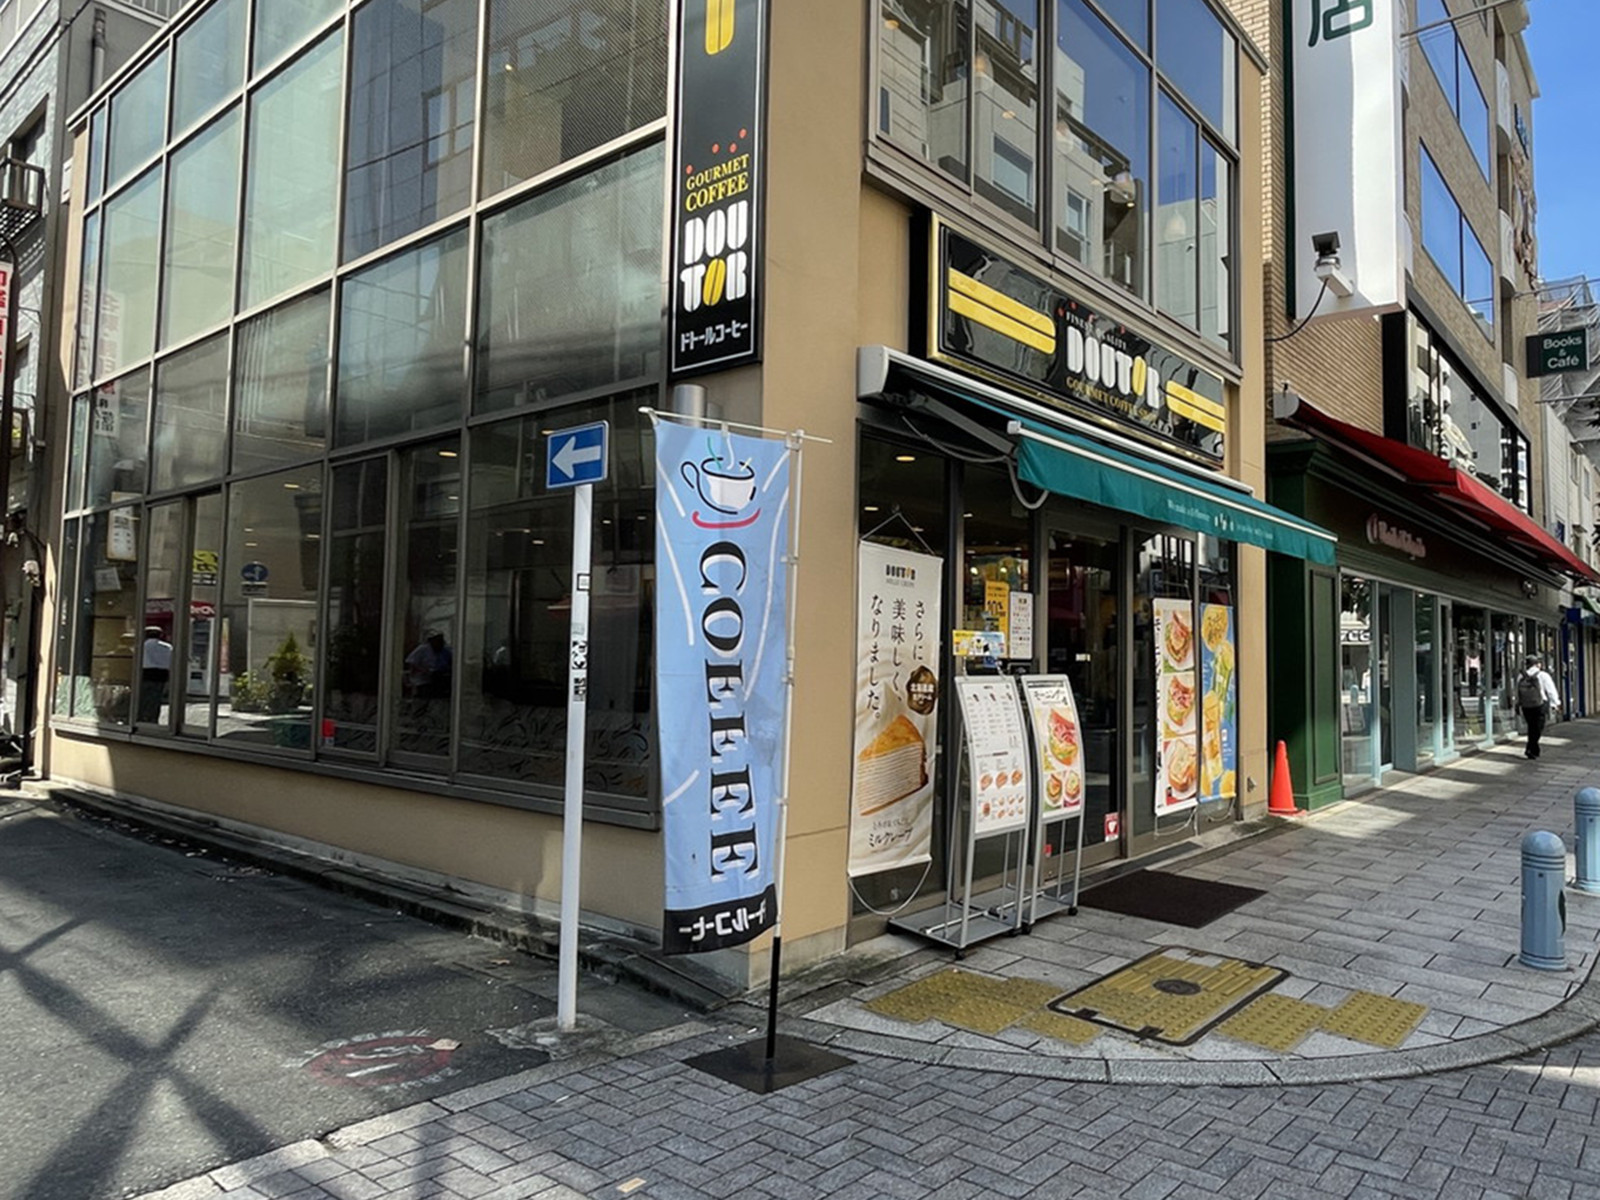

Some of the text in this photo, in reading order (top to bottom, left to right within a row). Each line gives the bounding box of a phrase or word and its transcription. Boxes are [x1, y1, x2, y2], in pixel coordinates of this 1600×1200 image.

[686, 153, 749, 190] GOURMET
[685, 172, 749, 212] COFFEE
[680, 320, 749, 352] ドトールコーヒー
[1543, 335, 1583, 350] Books
[1067, 325, 1160, 410] DOUTOR
[1547, 354, 1580, 369] Café
[913, 600, 925, 660] さらに
[867, 595, 882, 719] なりました。
